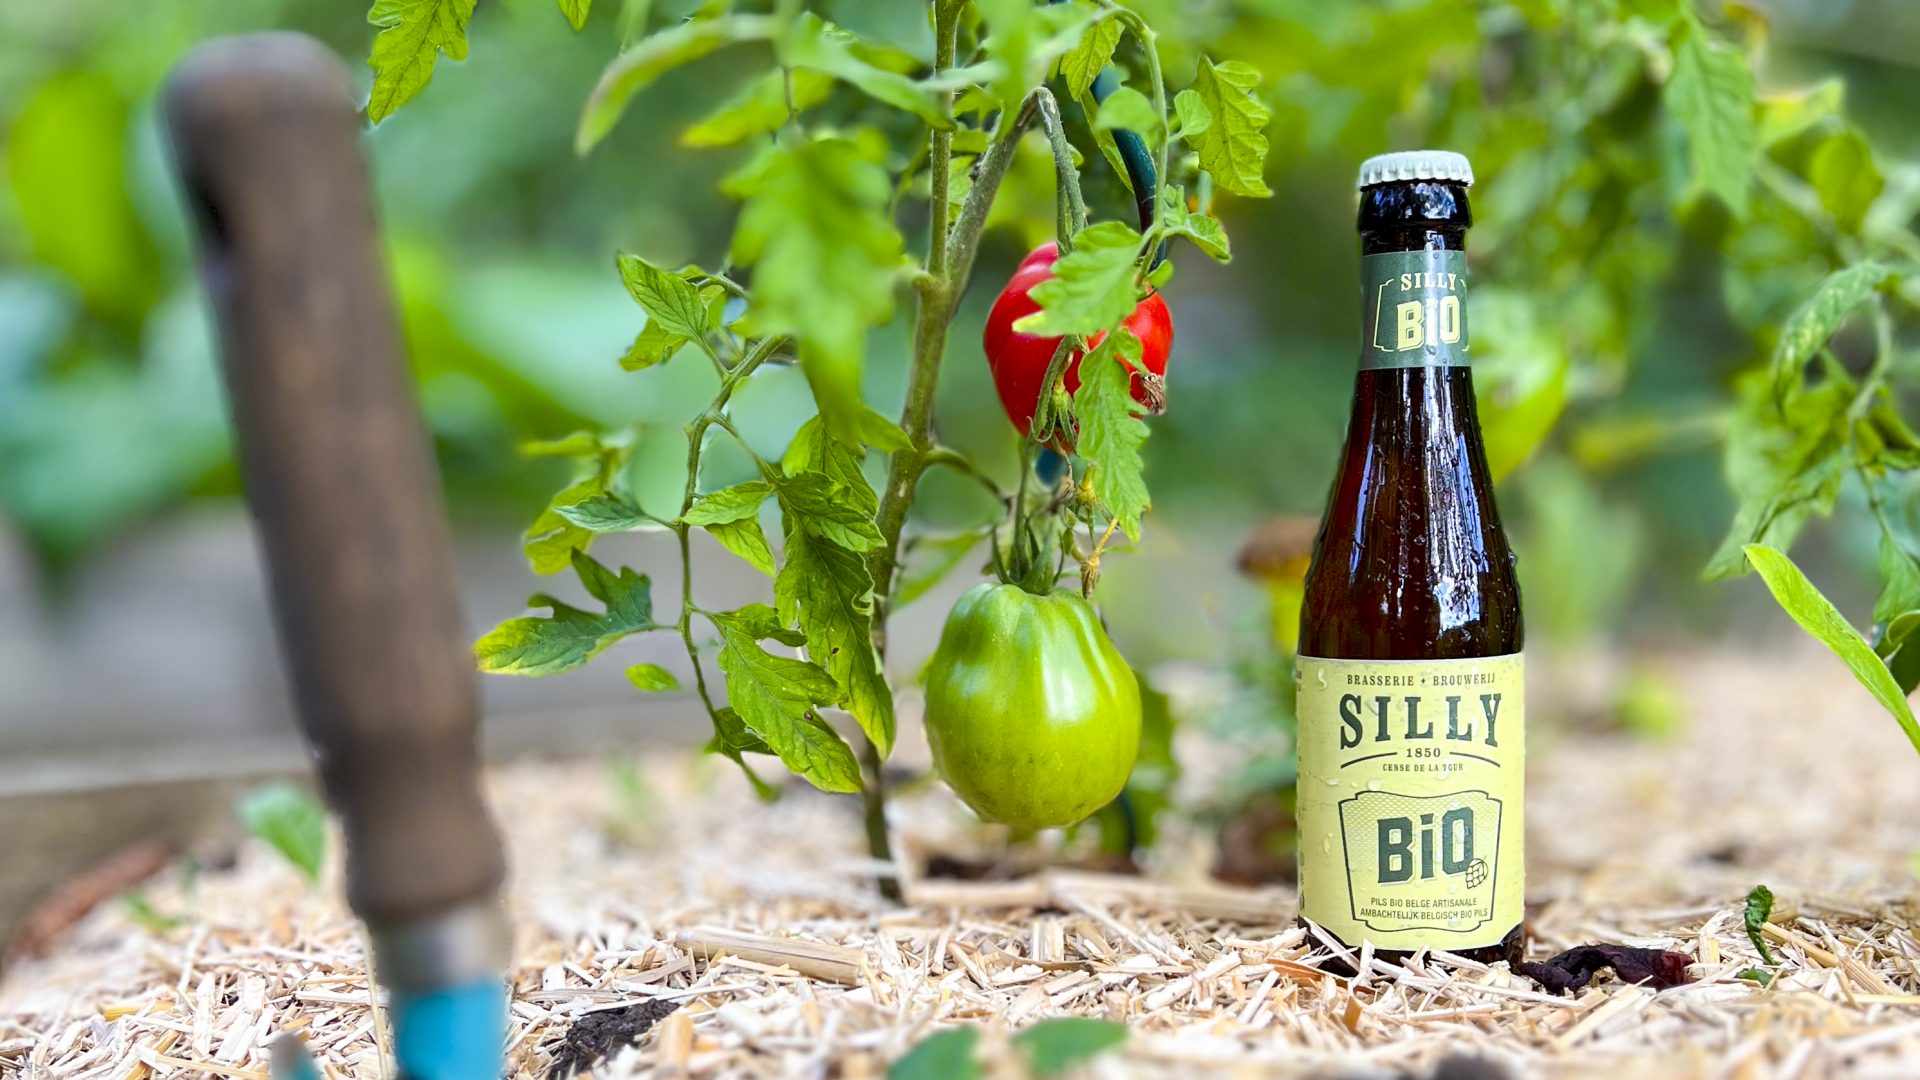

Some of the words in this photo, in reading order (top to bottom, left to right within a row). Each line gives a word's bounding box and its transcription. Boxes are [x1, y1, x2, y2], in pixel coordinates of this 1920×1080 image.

[1400, 272, 1457, 292] SILLY
[1347, 674, 1414, 686] BRASSERIE
[1432, 673, 1495, 686] BROUWERIJ
[1339, 693, 1502, 750] SILLY
[1406, 748, 1441, 758] 1850
[1382, 763, 1411, 772] CENSE
[1414, 763, 1425, 772] DE
[1428, 763, 1439, 772] LA
[1442, 763, 1464, 772] TOUR
[1370, 897, 1388, 906] PILS
[1389, 898, 1403, 907] BIO
[1405, 899, 1431, 908] BELGE
[1432, 897, 1477, 908] ARTISANALE
[1360, 907, 1419, 920] AMBACHTELIJK
[1421, 910, 1458, 920] BELGISCH
[1460, 909, 1473, 919] BIO
[1474, 907, 1488, 917] PILS
